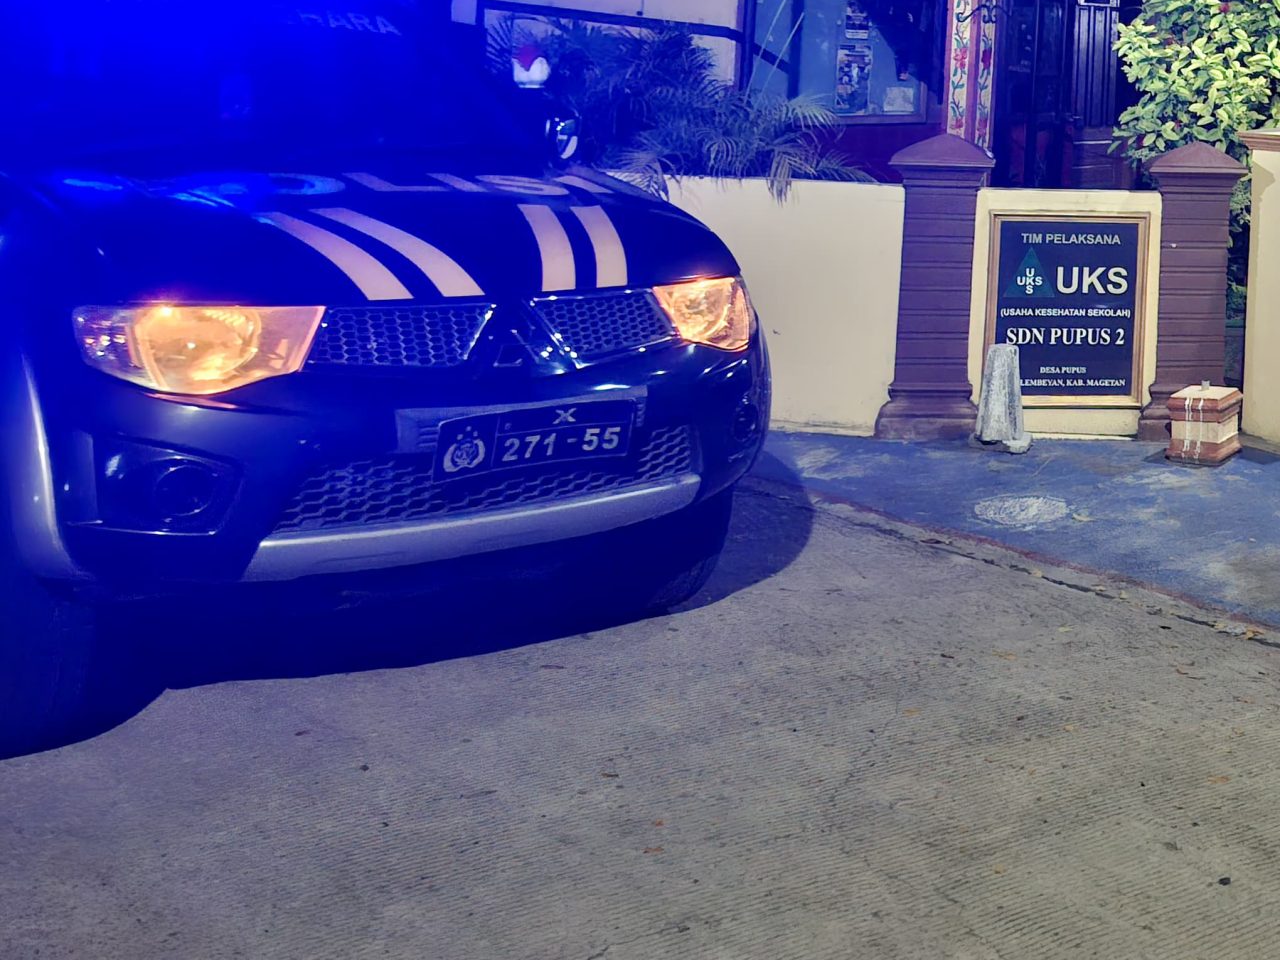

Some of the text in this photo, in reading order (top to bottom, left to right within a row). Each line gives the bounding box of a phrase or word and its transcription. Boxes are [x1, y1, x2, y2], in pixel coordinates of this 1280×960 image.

[170, 171, 613, 197] OLISI
[1021, 233, 1121, 246] TIM PELAKSANA
[1056, 266, 1129, 295] UKS
[1034, 308, 1086, 317] KESEHATAN
[1087, 309, 1131, 318] SEKOLAH)
[1006, 328, 1125, 346] SDN PUPUS 2
[1039, 366, 1087, 374] DESA PUPUS
[1086, 378, 1126, 387] MAGETAN
